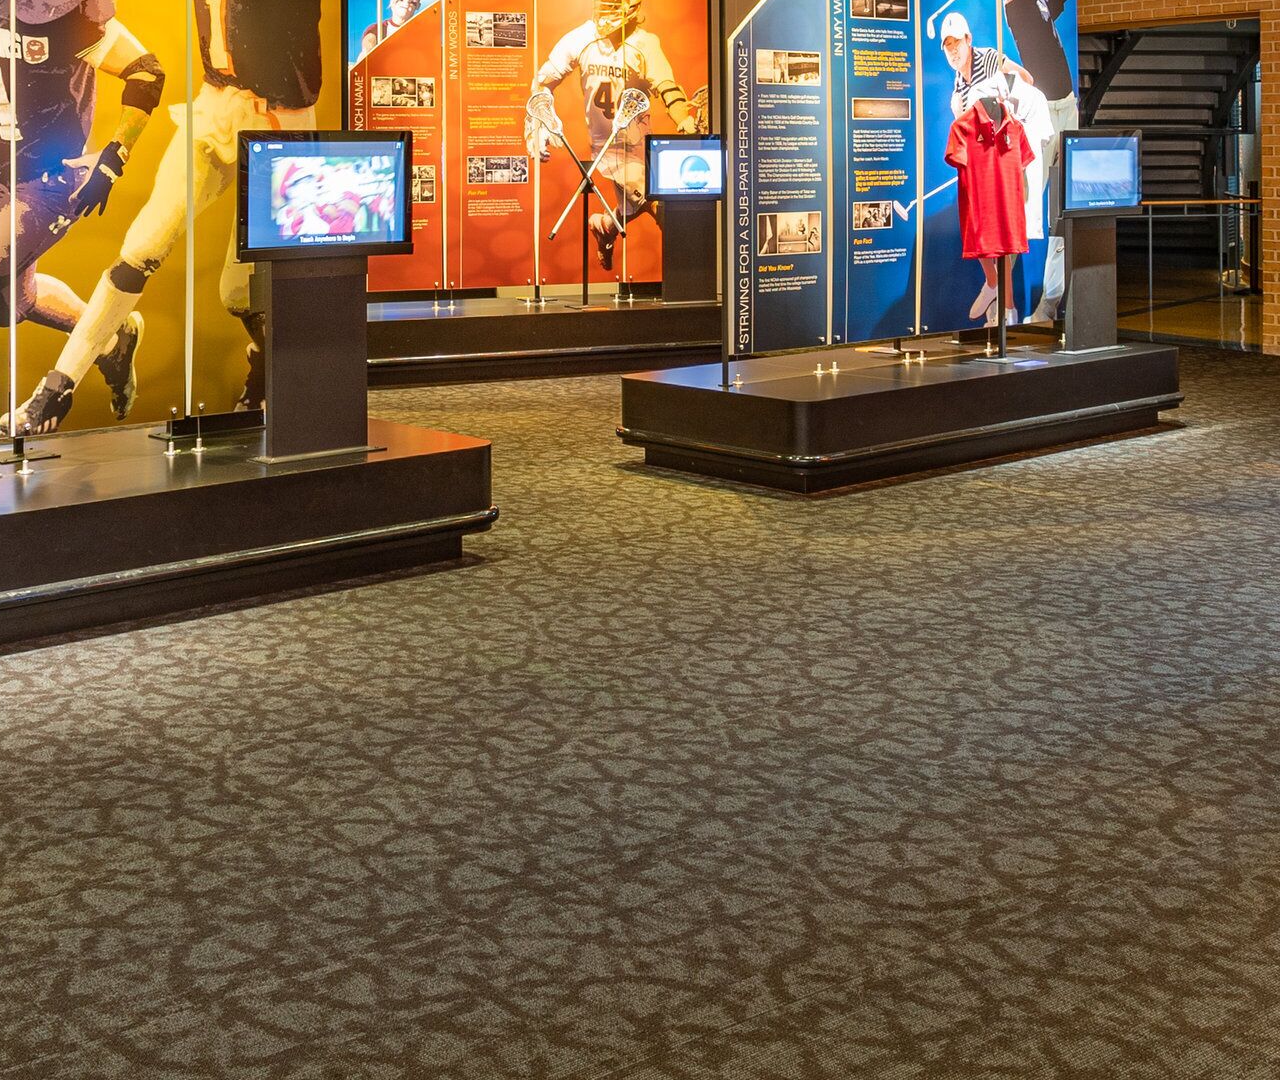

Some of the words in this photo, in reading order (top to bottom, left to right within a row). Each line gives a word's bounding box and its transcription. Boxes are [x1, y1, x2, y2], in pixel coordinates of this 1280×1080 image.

[449, 11, 458, 56] WORDS
[834, 25, 842, 43] MY
[834, 44, 842, 56] IN
[449, 58, 458, 72] MY
[354, 76, 364, 106] NAME
[738, 48, 749, 158] PERFORMANCE
[738, 163, 749, 227] SUB-PAR
[739, 230, 749, 240] A
[739, 245, 749, 273] FOR
[739, 278, 749, 344] STRIVING
